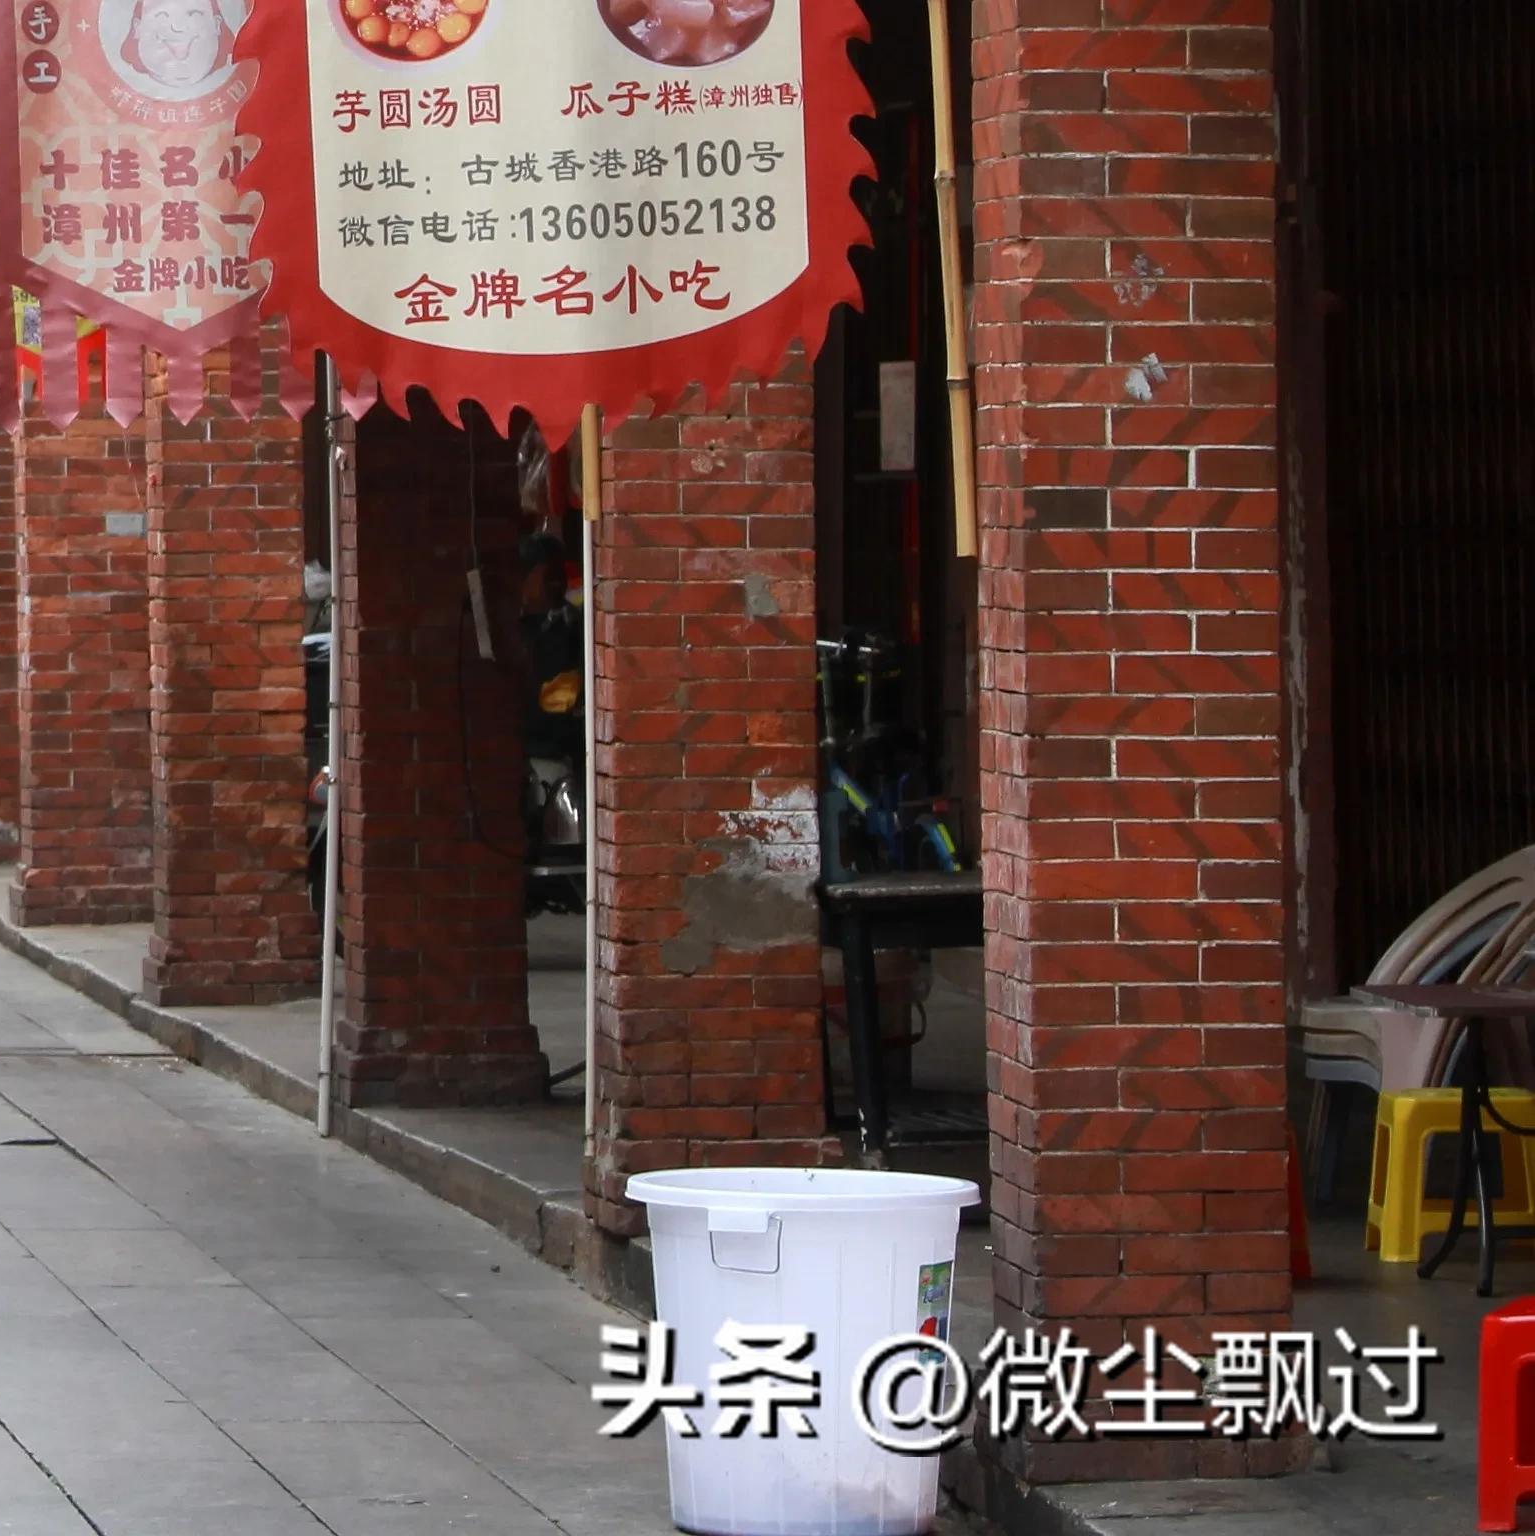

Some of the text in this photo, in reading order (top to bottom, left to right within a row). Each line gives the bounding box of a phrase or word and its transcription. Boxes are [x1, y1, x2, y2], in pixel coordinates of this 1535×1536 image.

[332, 83, 503, 133] 芋圆汤圆
[42, 200, 255, 245] 漳州第一
[113, 256, 251, 293] 金牌小吃
[394, 259, 732, 326] 金牌名小吃
